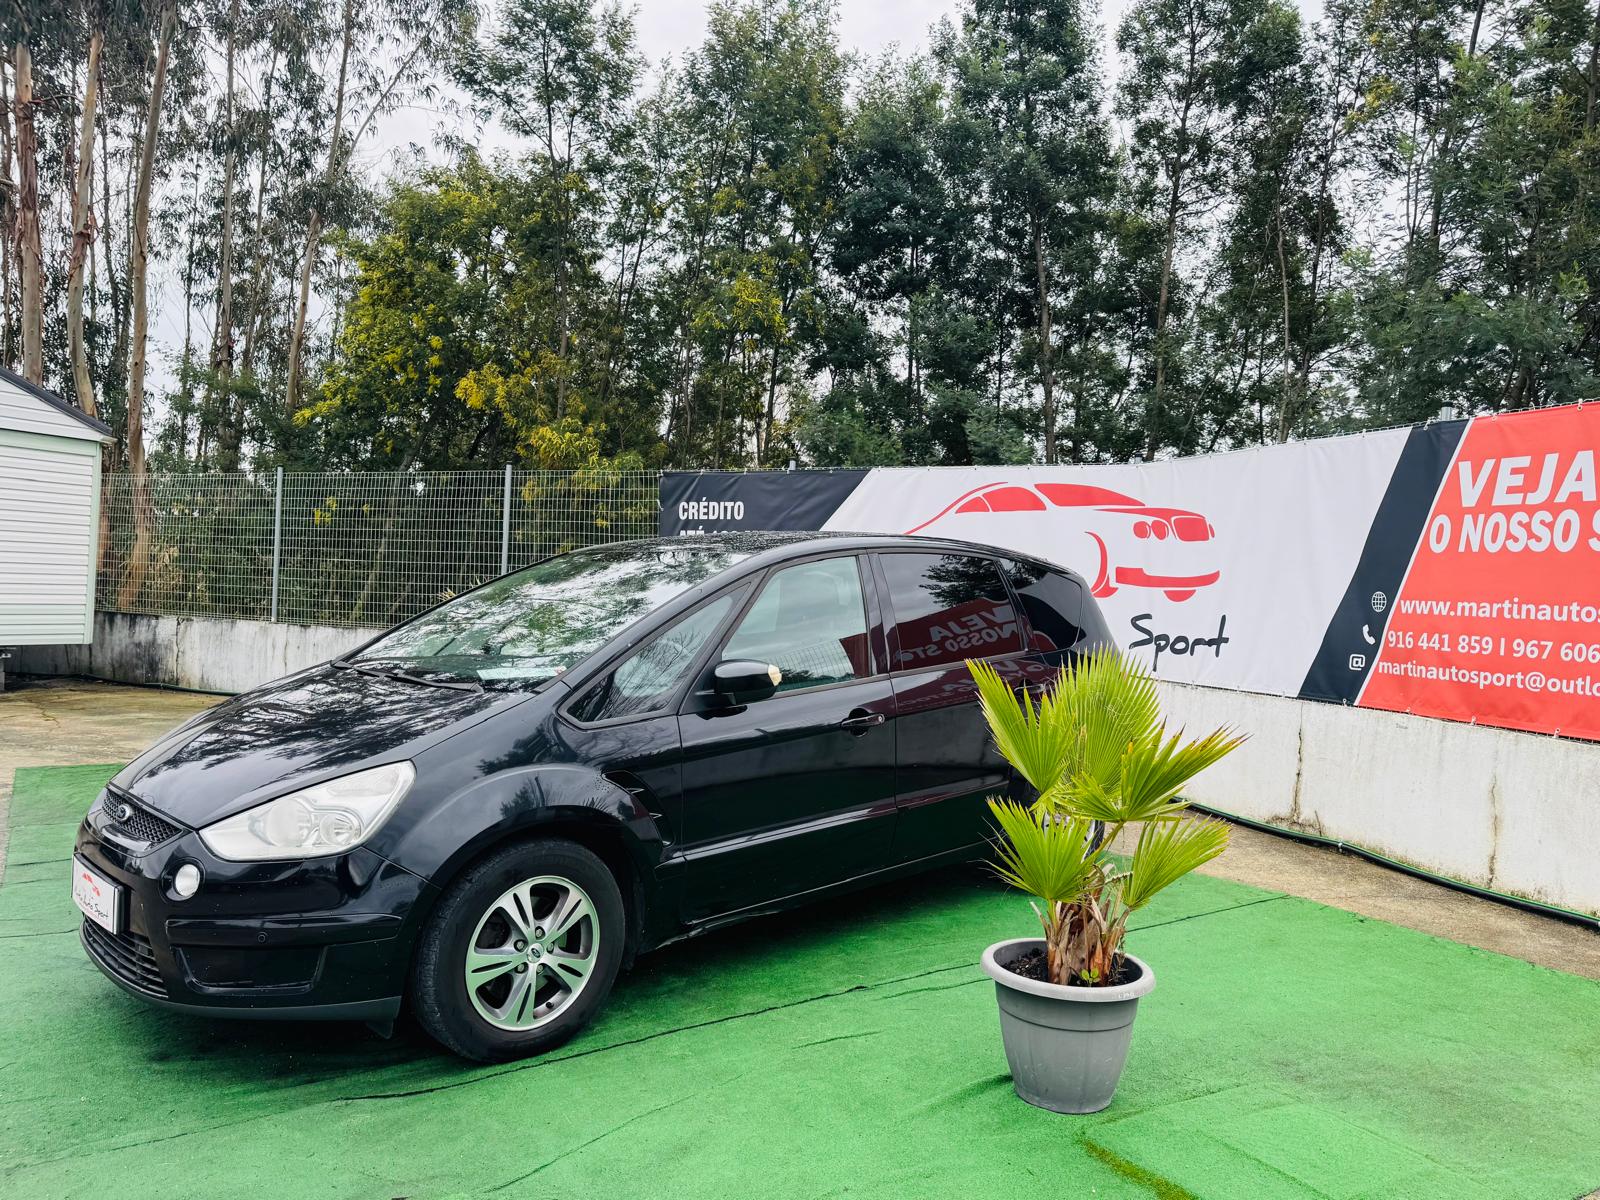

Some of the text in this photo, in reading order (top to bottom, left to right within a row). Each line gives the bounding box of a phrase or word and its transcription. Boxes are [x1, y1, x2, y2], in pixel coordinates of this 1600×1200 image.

[1457, 450, 1597, 508] VEJA
[678, 497, 745, 520] CRÉDITO
[1429, 514, 1452, 554] O
[1458, 509, 1581, 553] NOSSO
[1400, 597, 1600, 624] www.martinauto
[1129, 613, 1230, 673] Sport
[1387, 630, 1414, 649] 916
[1418, 633, 1452, 652] 441
[1457, 635, 1493, 655] 859
[1512, 639, 1553, 660] 967
